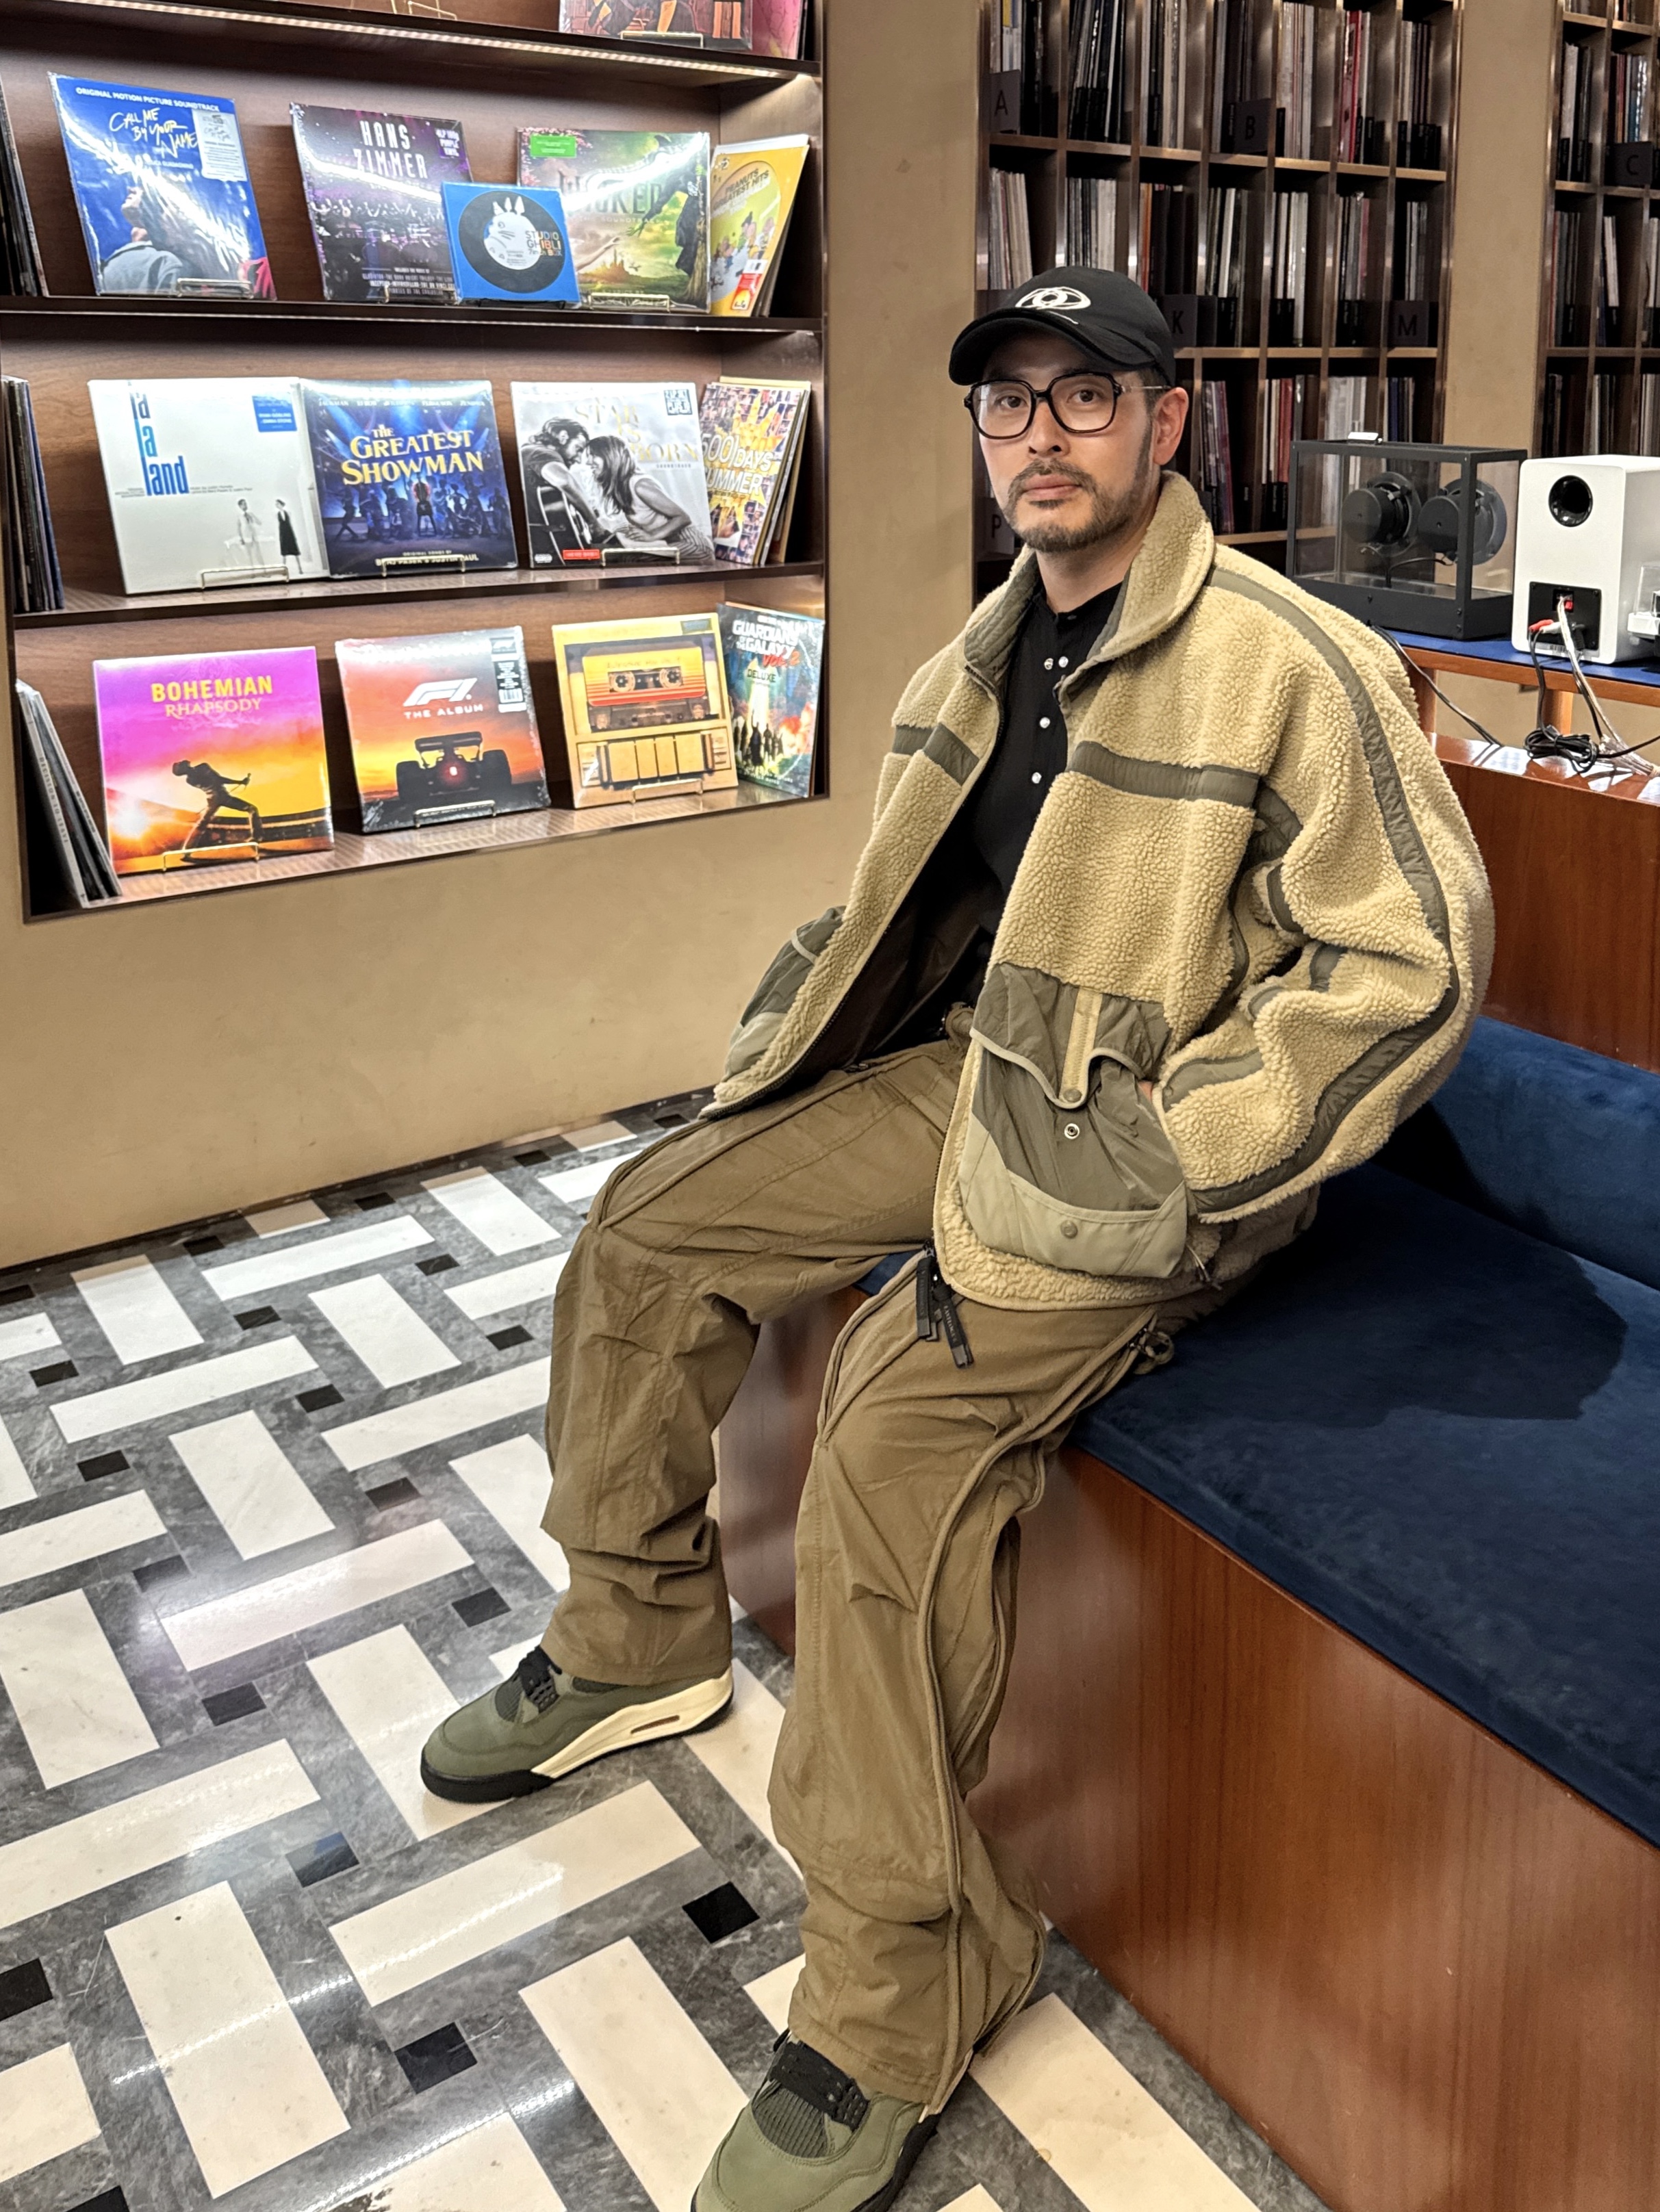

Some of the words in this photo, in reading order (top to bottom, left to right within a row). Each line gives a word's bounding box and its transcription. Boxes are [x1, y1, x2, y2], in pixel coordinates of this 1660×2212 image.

[75, 87, 112, 99] ORIGINAL
[113, 92, 142, 103] MOTION
[144, 96, 173, 107] PICTURE
[174, 99, 220, 112] SOUNDTRACK
[994, 90, 1008, 116] A
[109, 112, 142, 132] CALL
[142, 107, 161, 126] ME
[1245, 115, 1256, 140] B
[132, 126, 149, 142] BY
[149, 120, 188, 146] YOUR
[156, 131, 198, 159] NAME
[359, 120, 411, 150] HANS
[353, 149, 429, 179] ZIMMER
[1626, 155, 1639, 175] C
[557, 169, 663, 214] WCKED
[726, 168, 759, 192] PEANUTS
[752, 170, 769, 188] HITS
[524, 230, 559, 240] STUDIO
[526, 239, 561, 250] GHIBLI
[1173, 311, 1184, 334] K
[1399, 315, 1417, 336] M
[134, 418, 158, 457] la
[350, 429, 474, 459] GREATEST
[372, 425, 395, 438] THE
[141, 455, 190, 496] land
[341, 451, 484, 485] SHOWMAN
[704, 466, 764, 496] UMMER
[992, 514, 1001, 539] P
[374, 558, 396, 567] BNJ
[732, 619, 799, 647] GUARDIANS
[745, 637, 795, 659] GALAXY
[789, 650, 800, 667] 2
[747, 669, 776, 683] DELUXE
[151, 675, 273, 703] BOHEMIAN
[165, 697, 262, 720] RHAPSODY
[403, 709, 431, 719] THE
[437, 704, 484, 716] ALBUM
